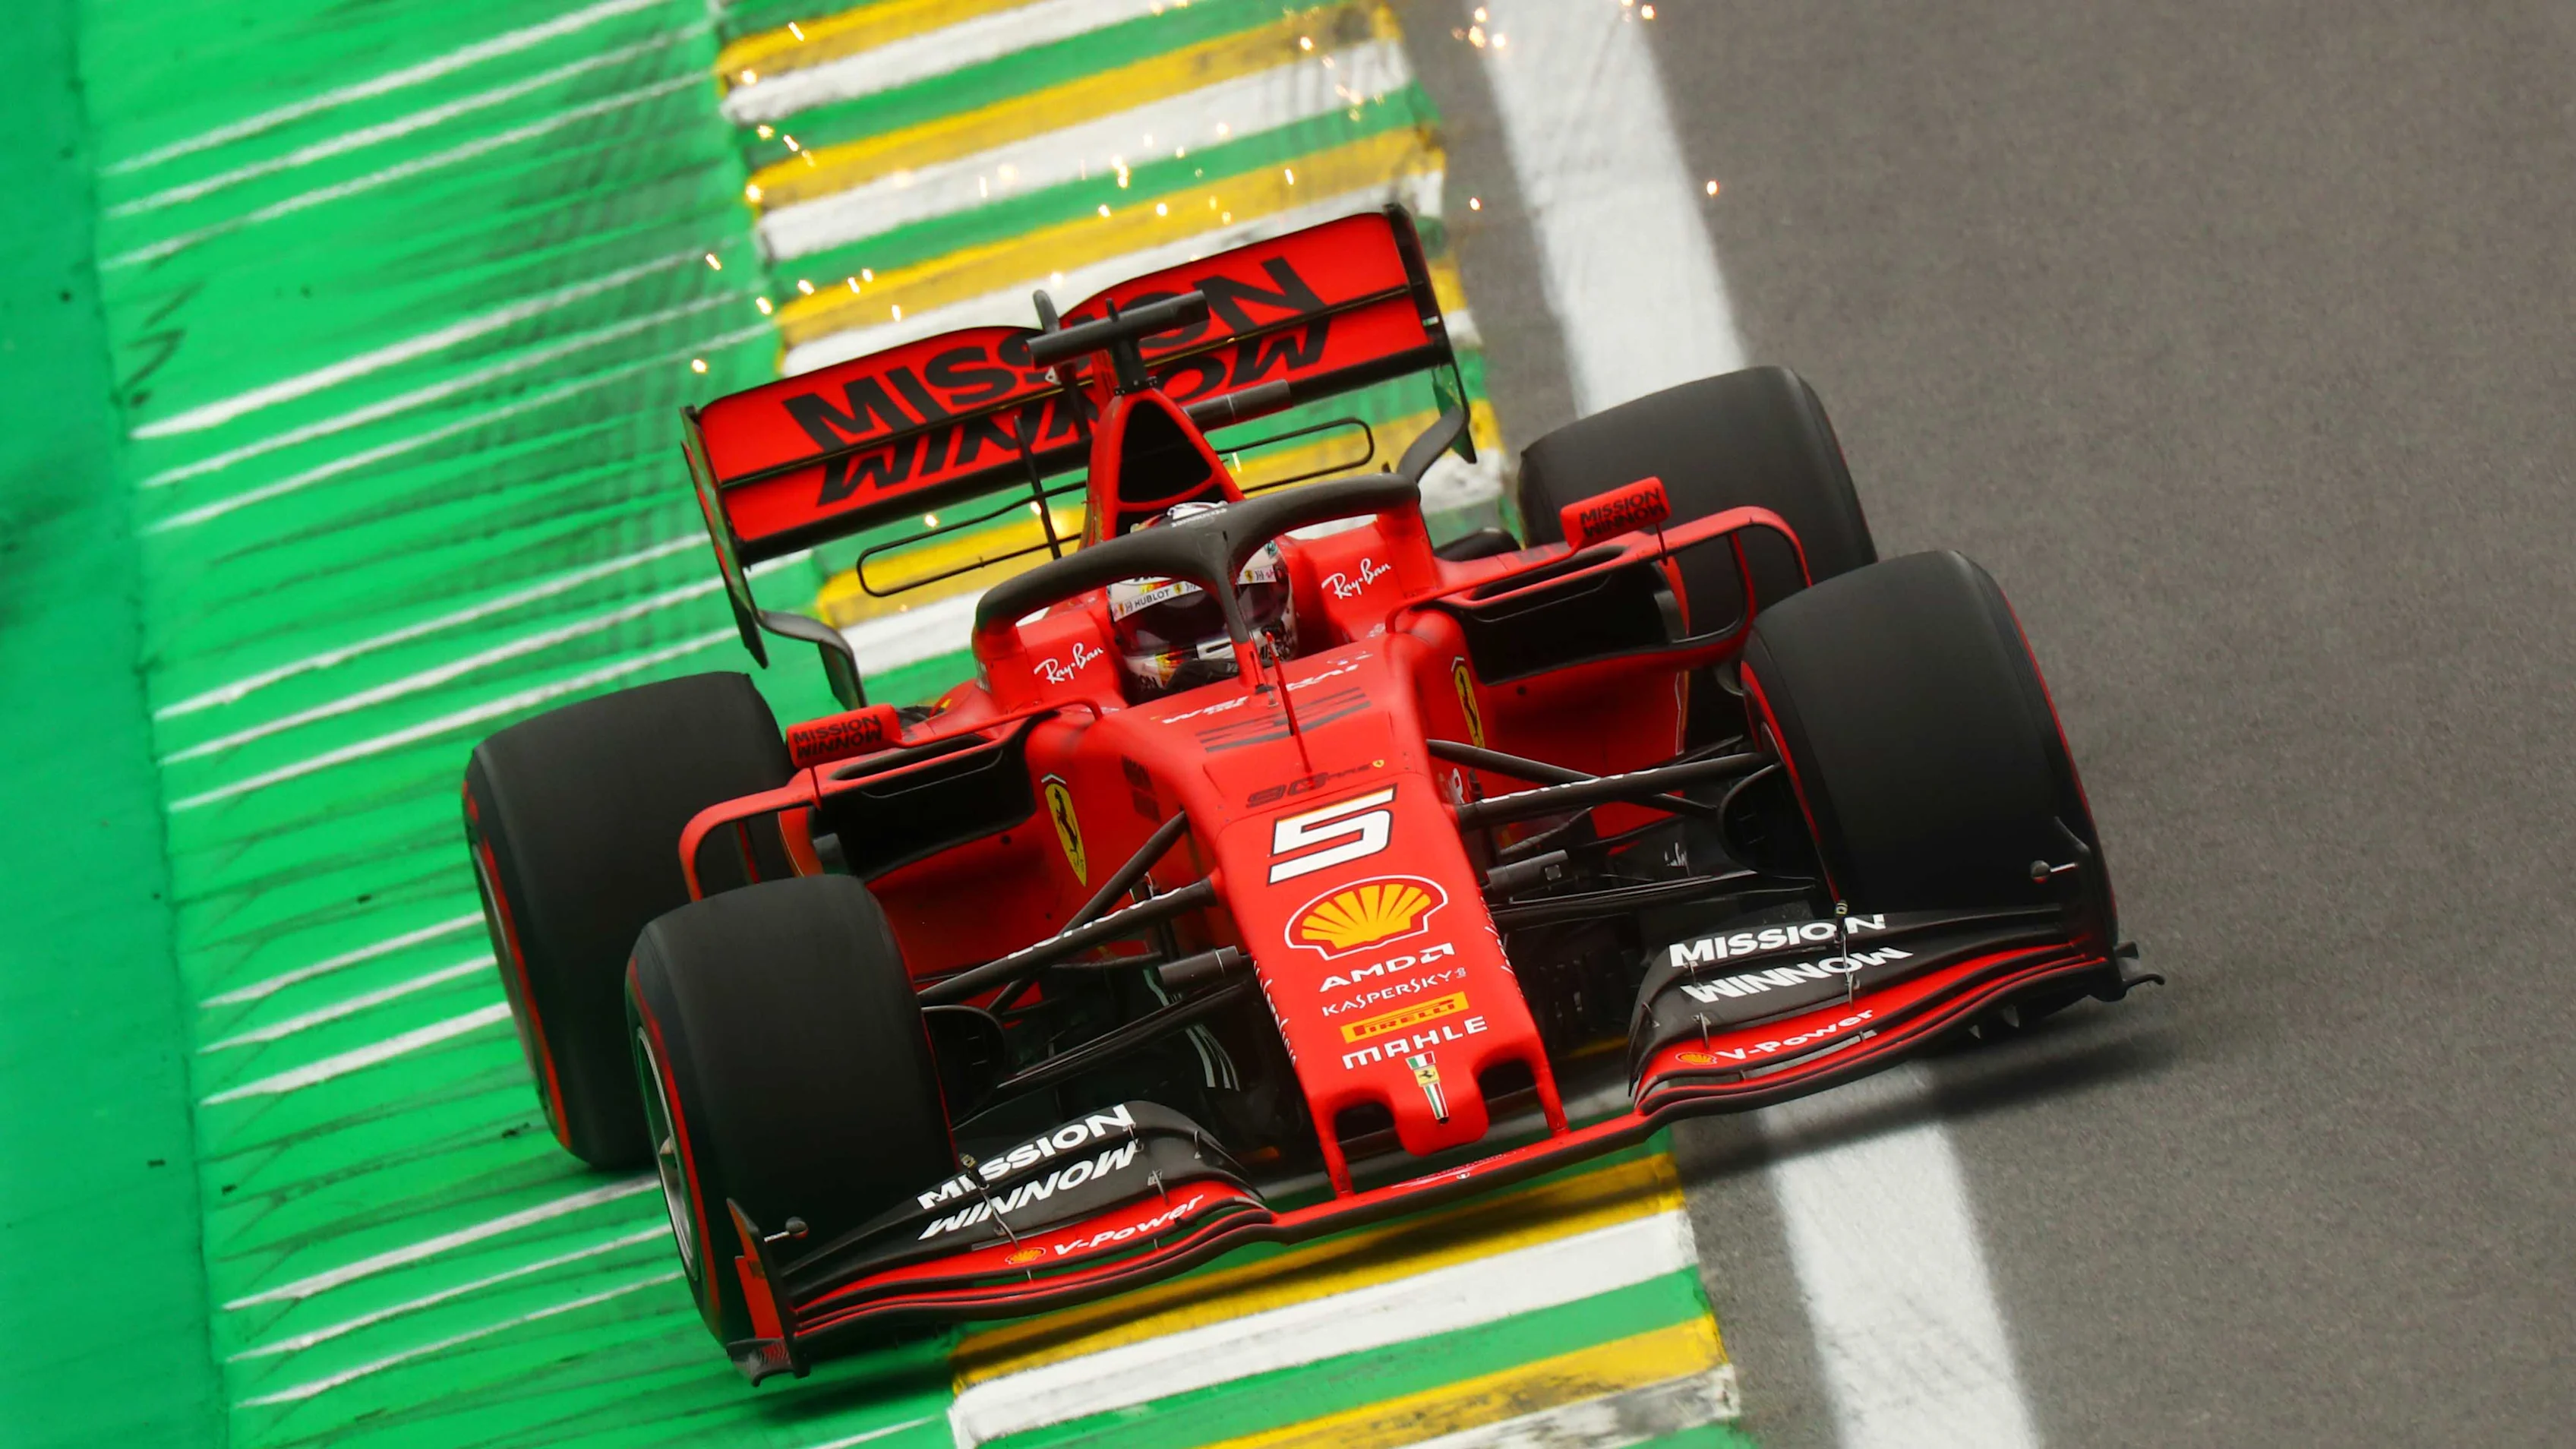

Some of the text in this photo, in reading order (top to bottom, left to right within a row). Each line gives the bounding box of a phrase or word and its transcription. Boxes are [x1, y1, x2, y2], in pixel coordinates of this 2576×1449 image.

[1580, 488, 1661, 524] MISSION
[1583, 504, 1665, 538] WINNOW
[1135, 589, 1170, 607] HUBLOT
[1322, 557, 1391, 599] Ray-Ban
[1034, 642, 1104, 684] Ray-Ban
[793, 715, 882, 744] MISSION
[797, 728, 883, 758] WINNOW
[1266, 783, 1397, 886] 5
[1668, 914, 1886, 968] MISSION
[1321, 970, 1452, 1017] KASPERSKY
[1681, 946, 1914, 1003] WINNOW
[1342, 1015, 1488, 1070] MAHLE
[1716, 1009, 1874, 1060] V-Power
[917, 1103, 1137, 1210] MISSION
[917, 1139, 1139, 1241] WINNOW
[1053, 1194, 1204, 1256] V-Power
